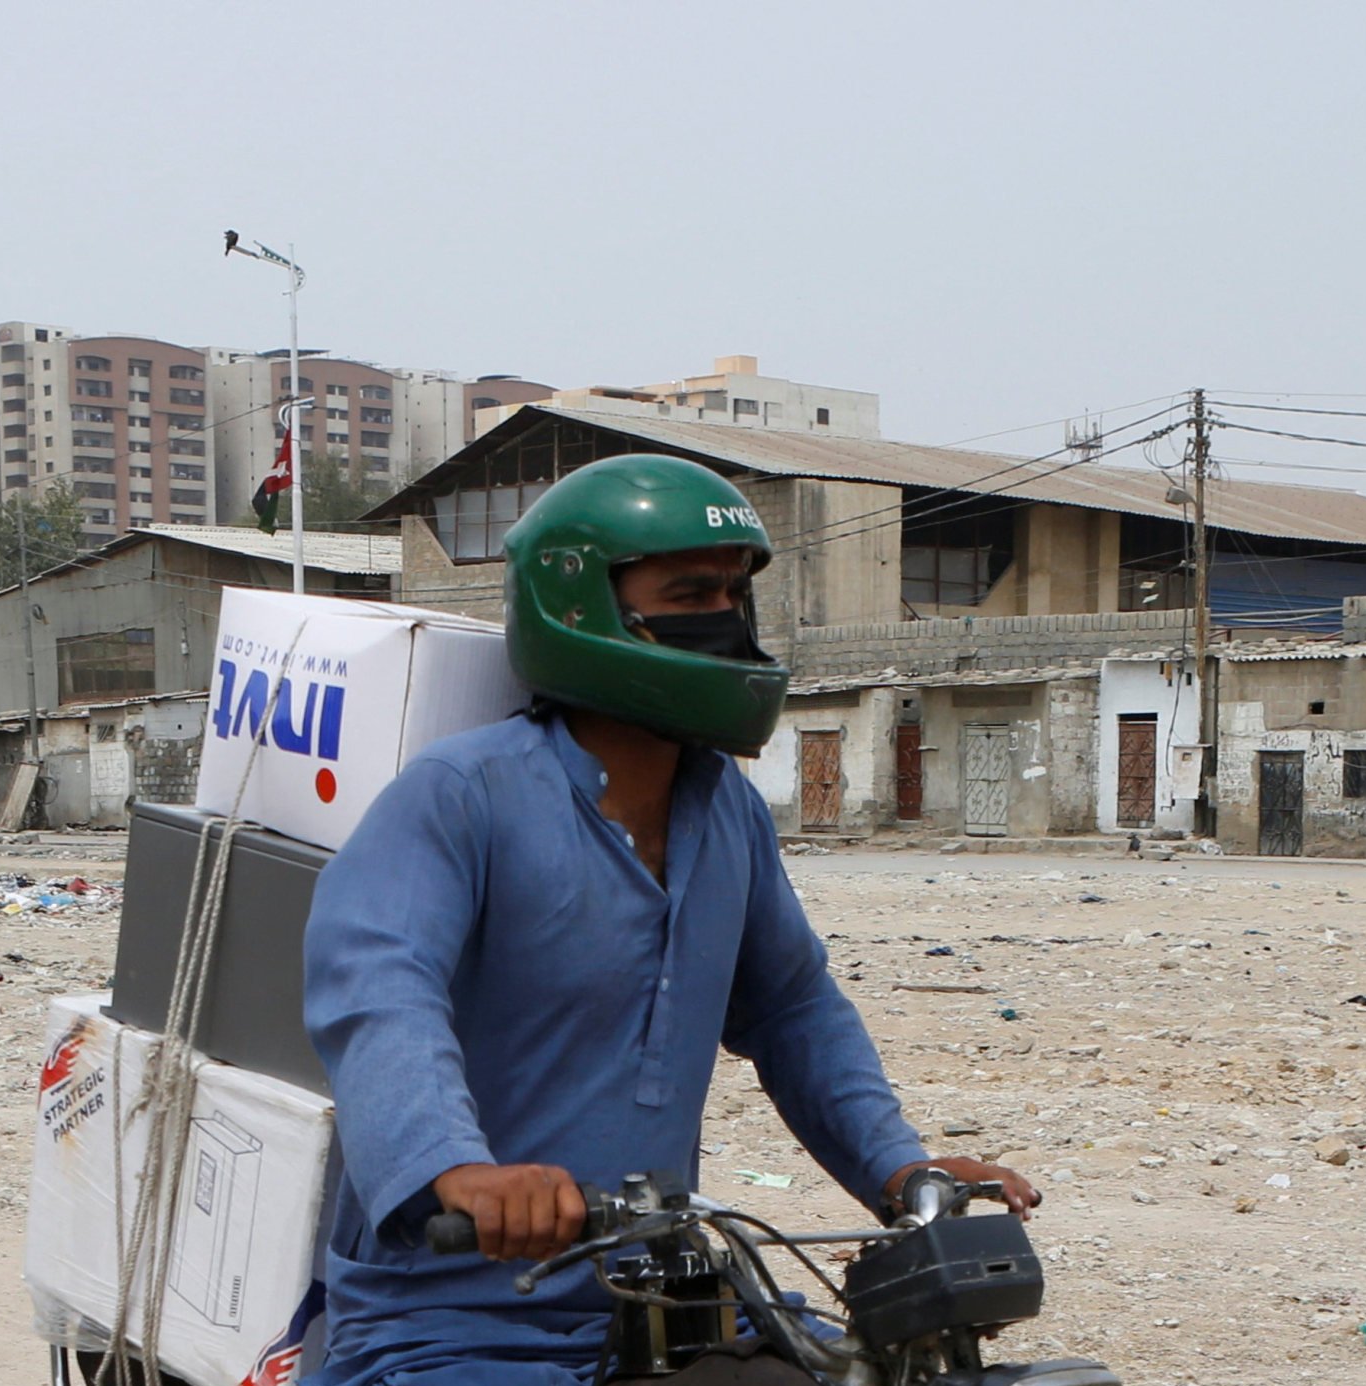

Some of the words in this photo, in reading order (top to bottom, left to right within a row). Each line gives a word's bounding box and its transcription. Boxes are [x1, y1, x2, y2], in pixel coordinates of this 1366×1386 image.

[212, 658, 346, 804] invt
[44, 1067, 105, 1126] STRATEGIC
[53, 1093, 105, 1143] PARTNER
